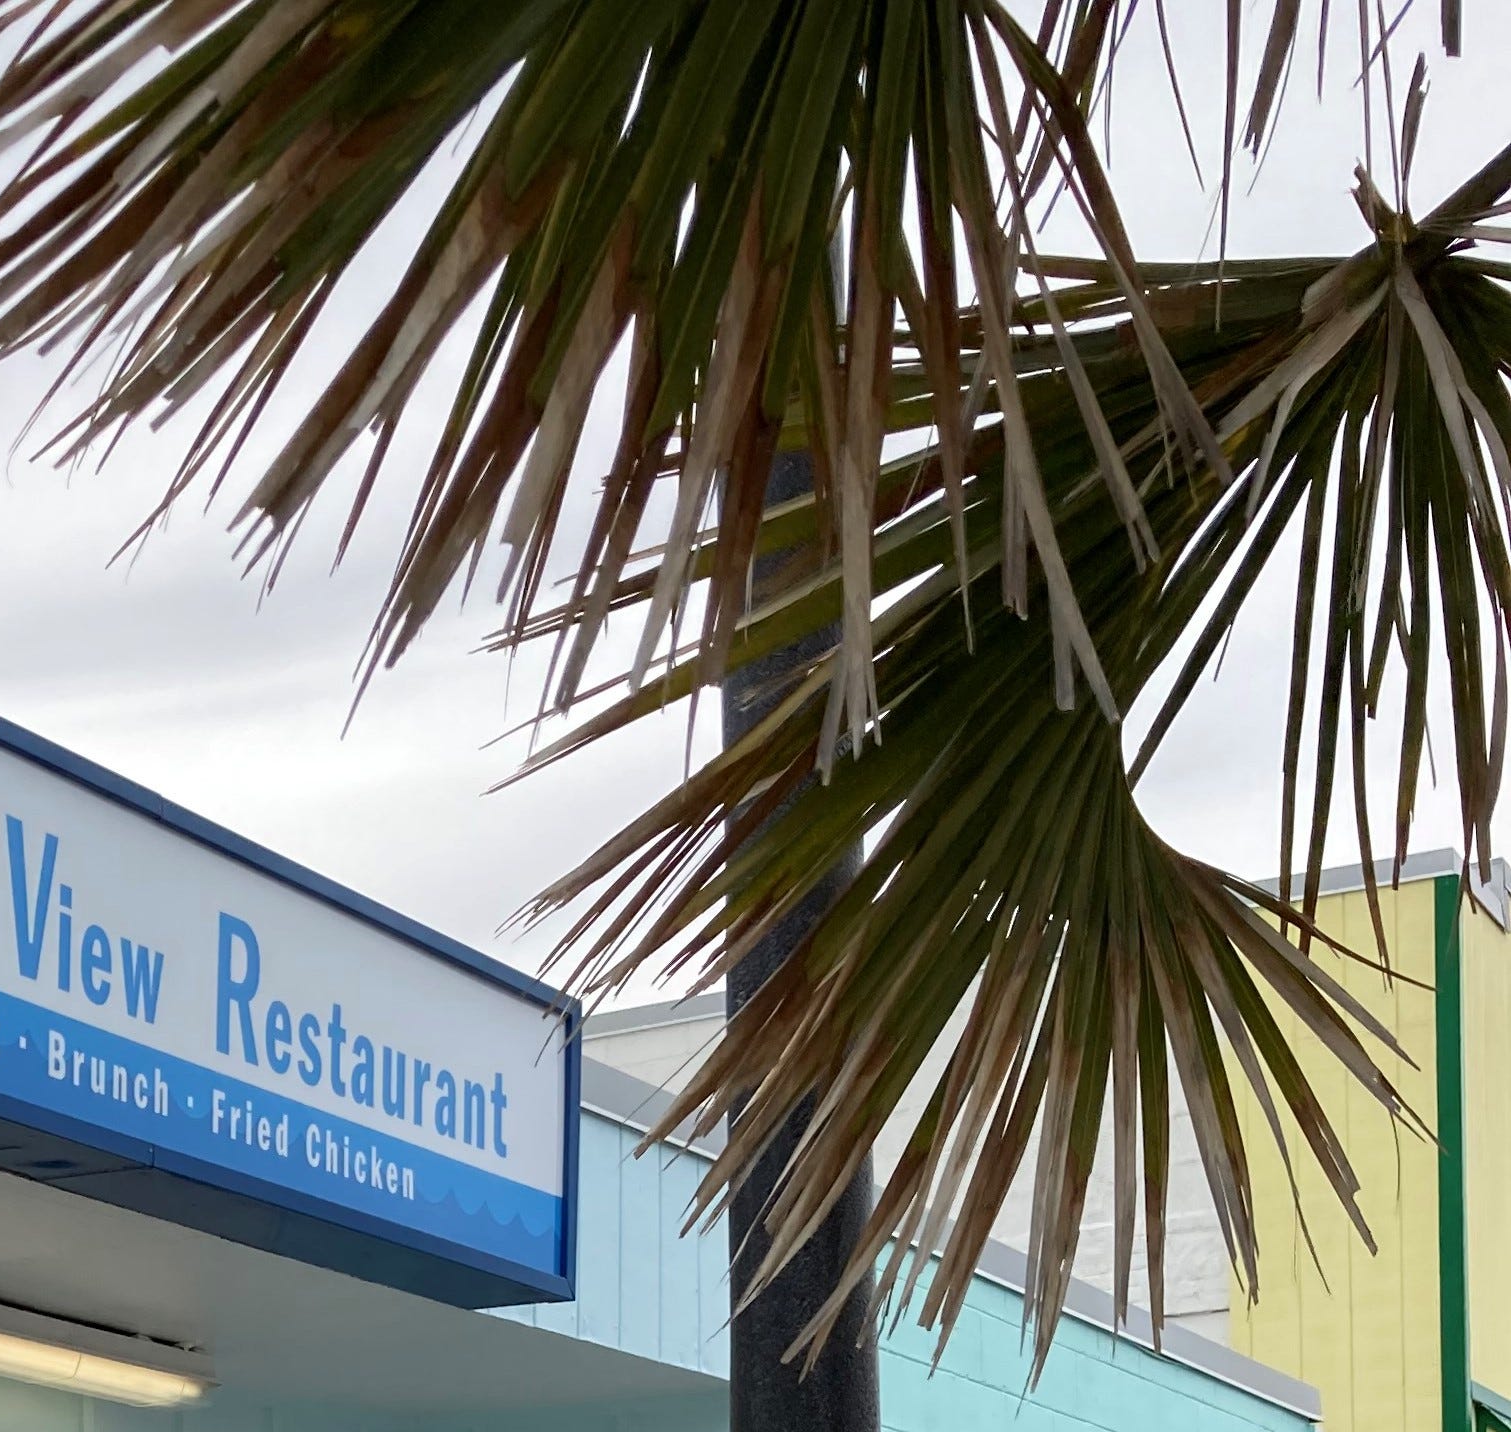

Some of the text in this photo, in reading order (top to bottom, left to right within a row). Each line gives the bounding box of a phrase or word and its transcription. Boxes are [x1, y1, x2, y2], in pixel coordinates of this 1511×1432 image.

[5, 814, 164, 1025] View
[217, 911, 509, 1158] Restaurant
[47, 1030, 171, 1117] Brunch
[211, 1089, 288, 1158] Fried
[305, 1126, 416, 1200] Chicken
